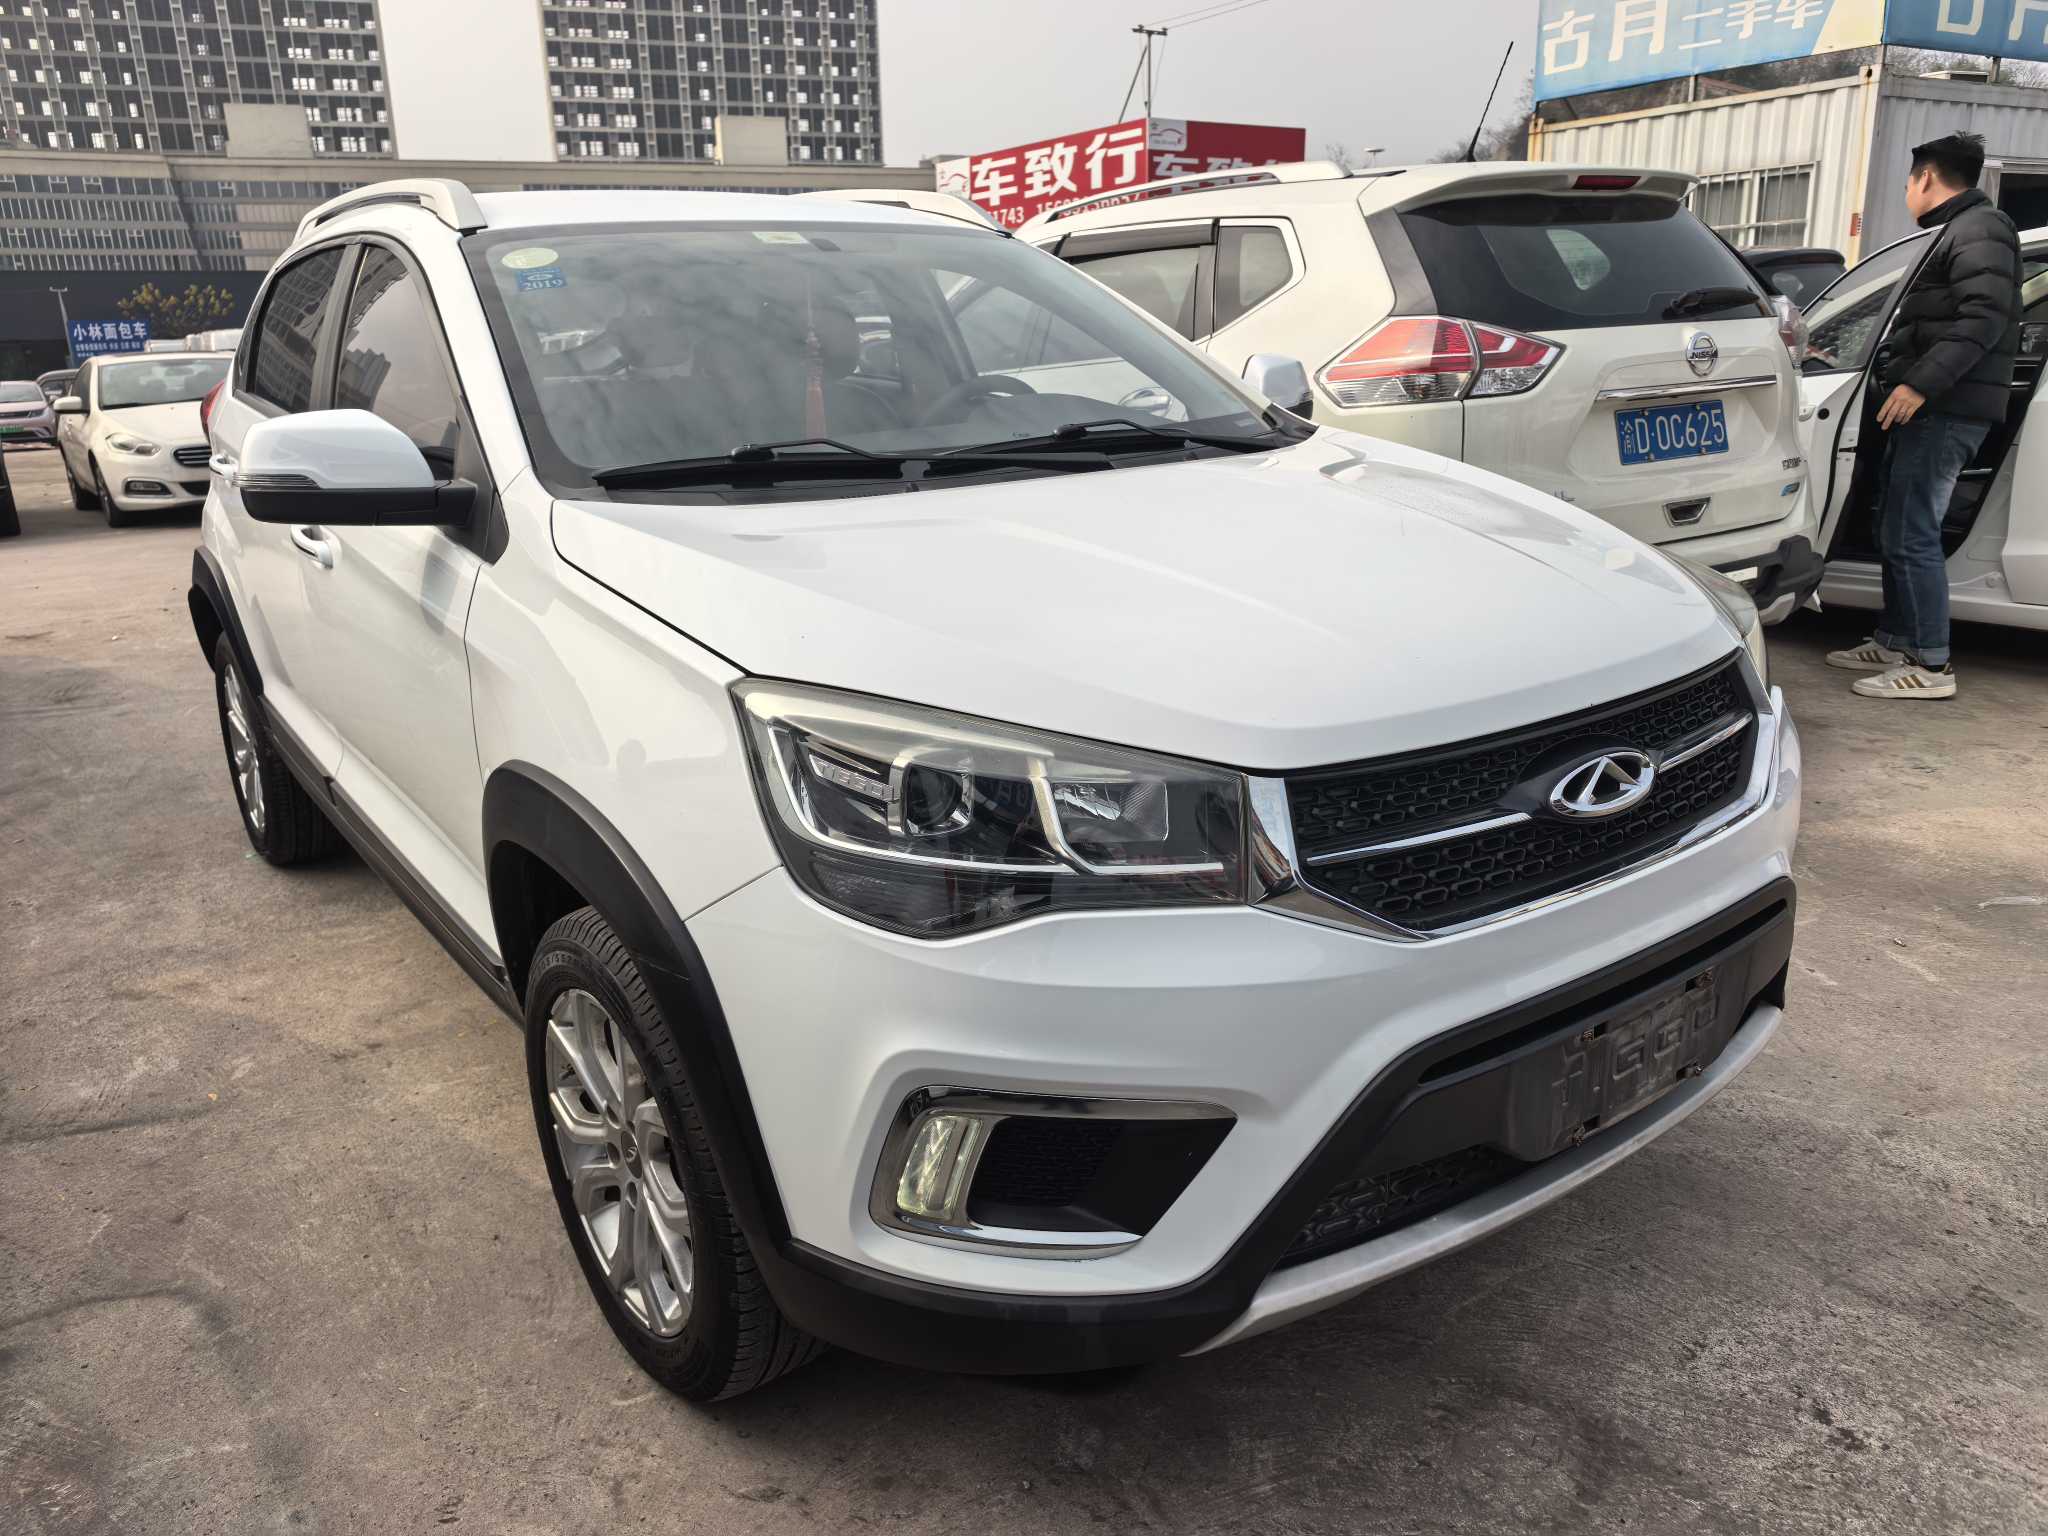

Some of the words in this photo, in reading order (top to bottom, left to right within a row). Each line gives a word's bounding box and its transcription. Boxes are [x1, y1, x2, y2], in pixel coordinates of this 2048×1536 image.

[971, 127, 1145, 207] 车致行
[522, 279, 563, 290] 2019
[73, 321, 147, 341] 小林面包车
